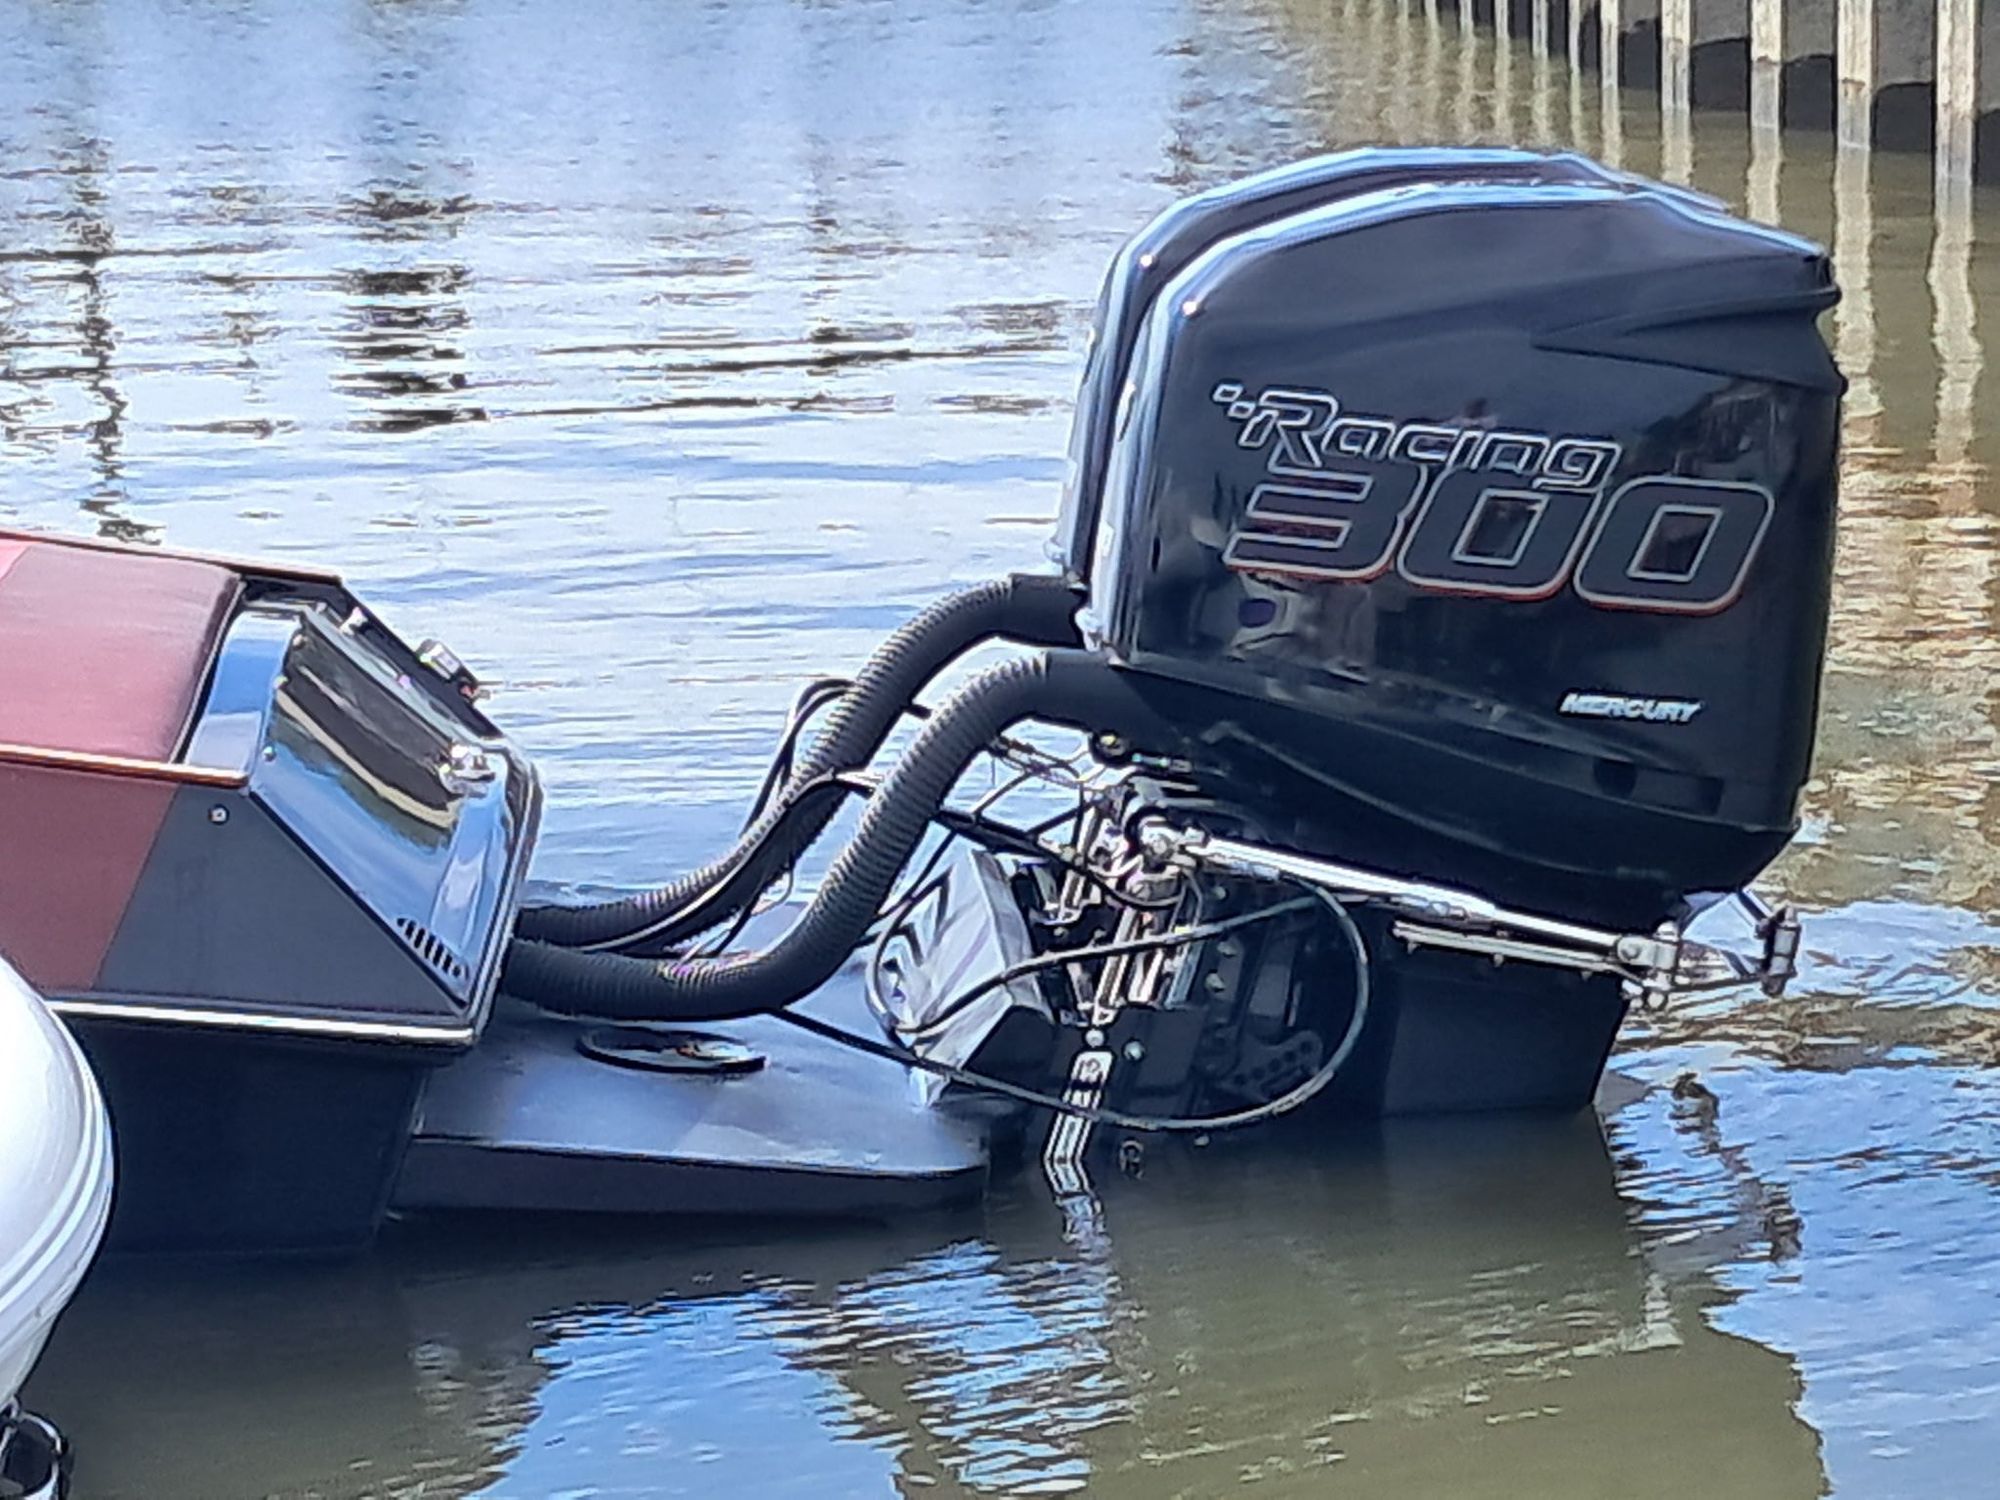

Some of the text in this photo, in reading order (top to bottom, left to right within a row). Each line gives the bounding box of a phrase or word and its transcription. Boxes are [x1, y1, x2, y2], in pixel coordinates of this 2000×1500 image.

[1232, 387, 1621, 488] Racing
[1222, 452, 1775, 615] 300
[1560, 692, 1701, 723] MERCURY
